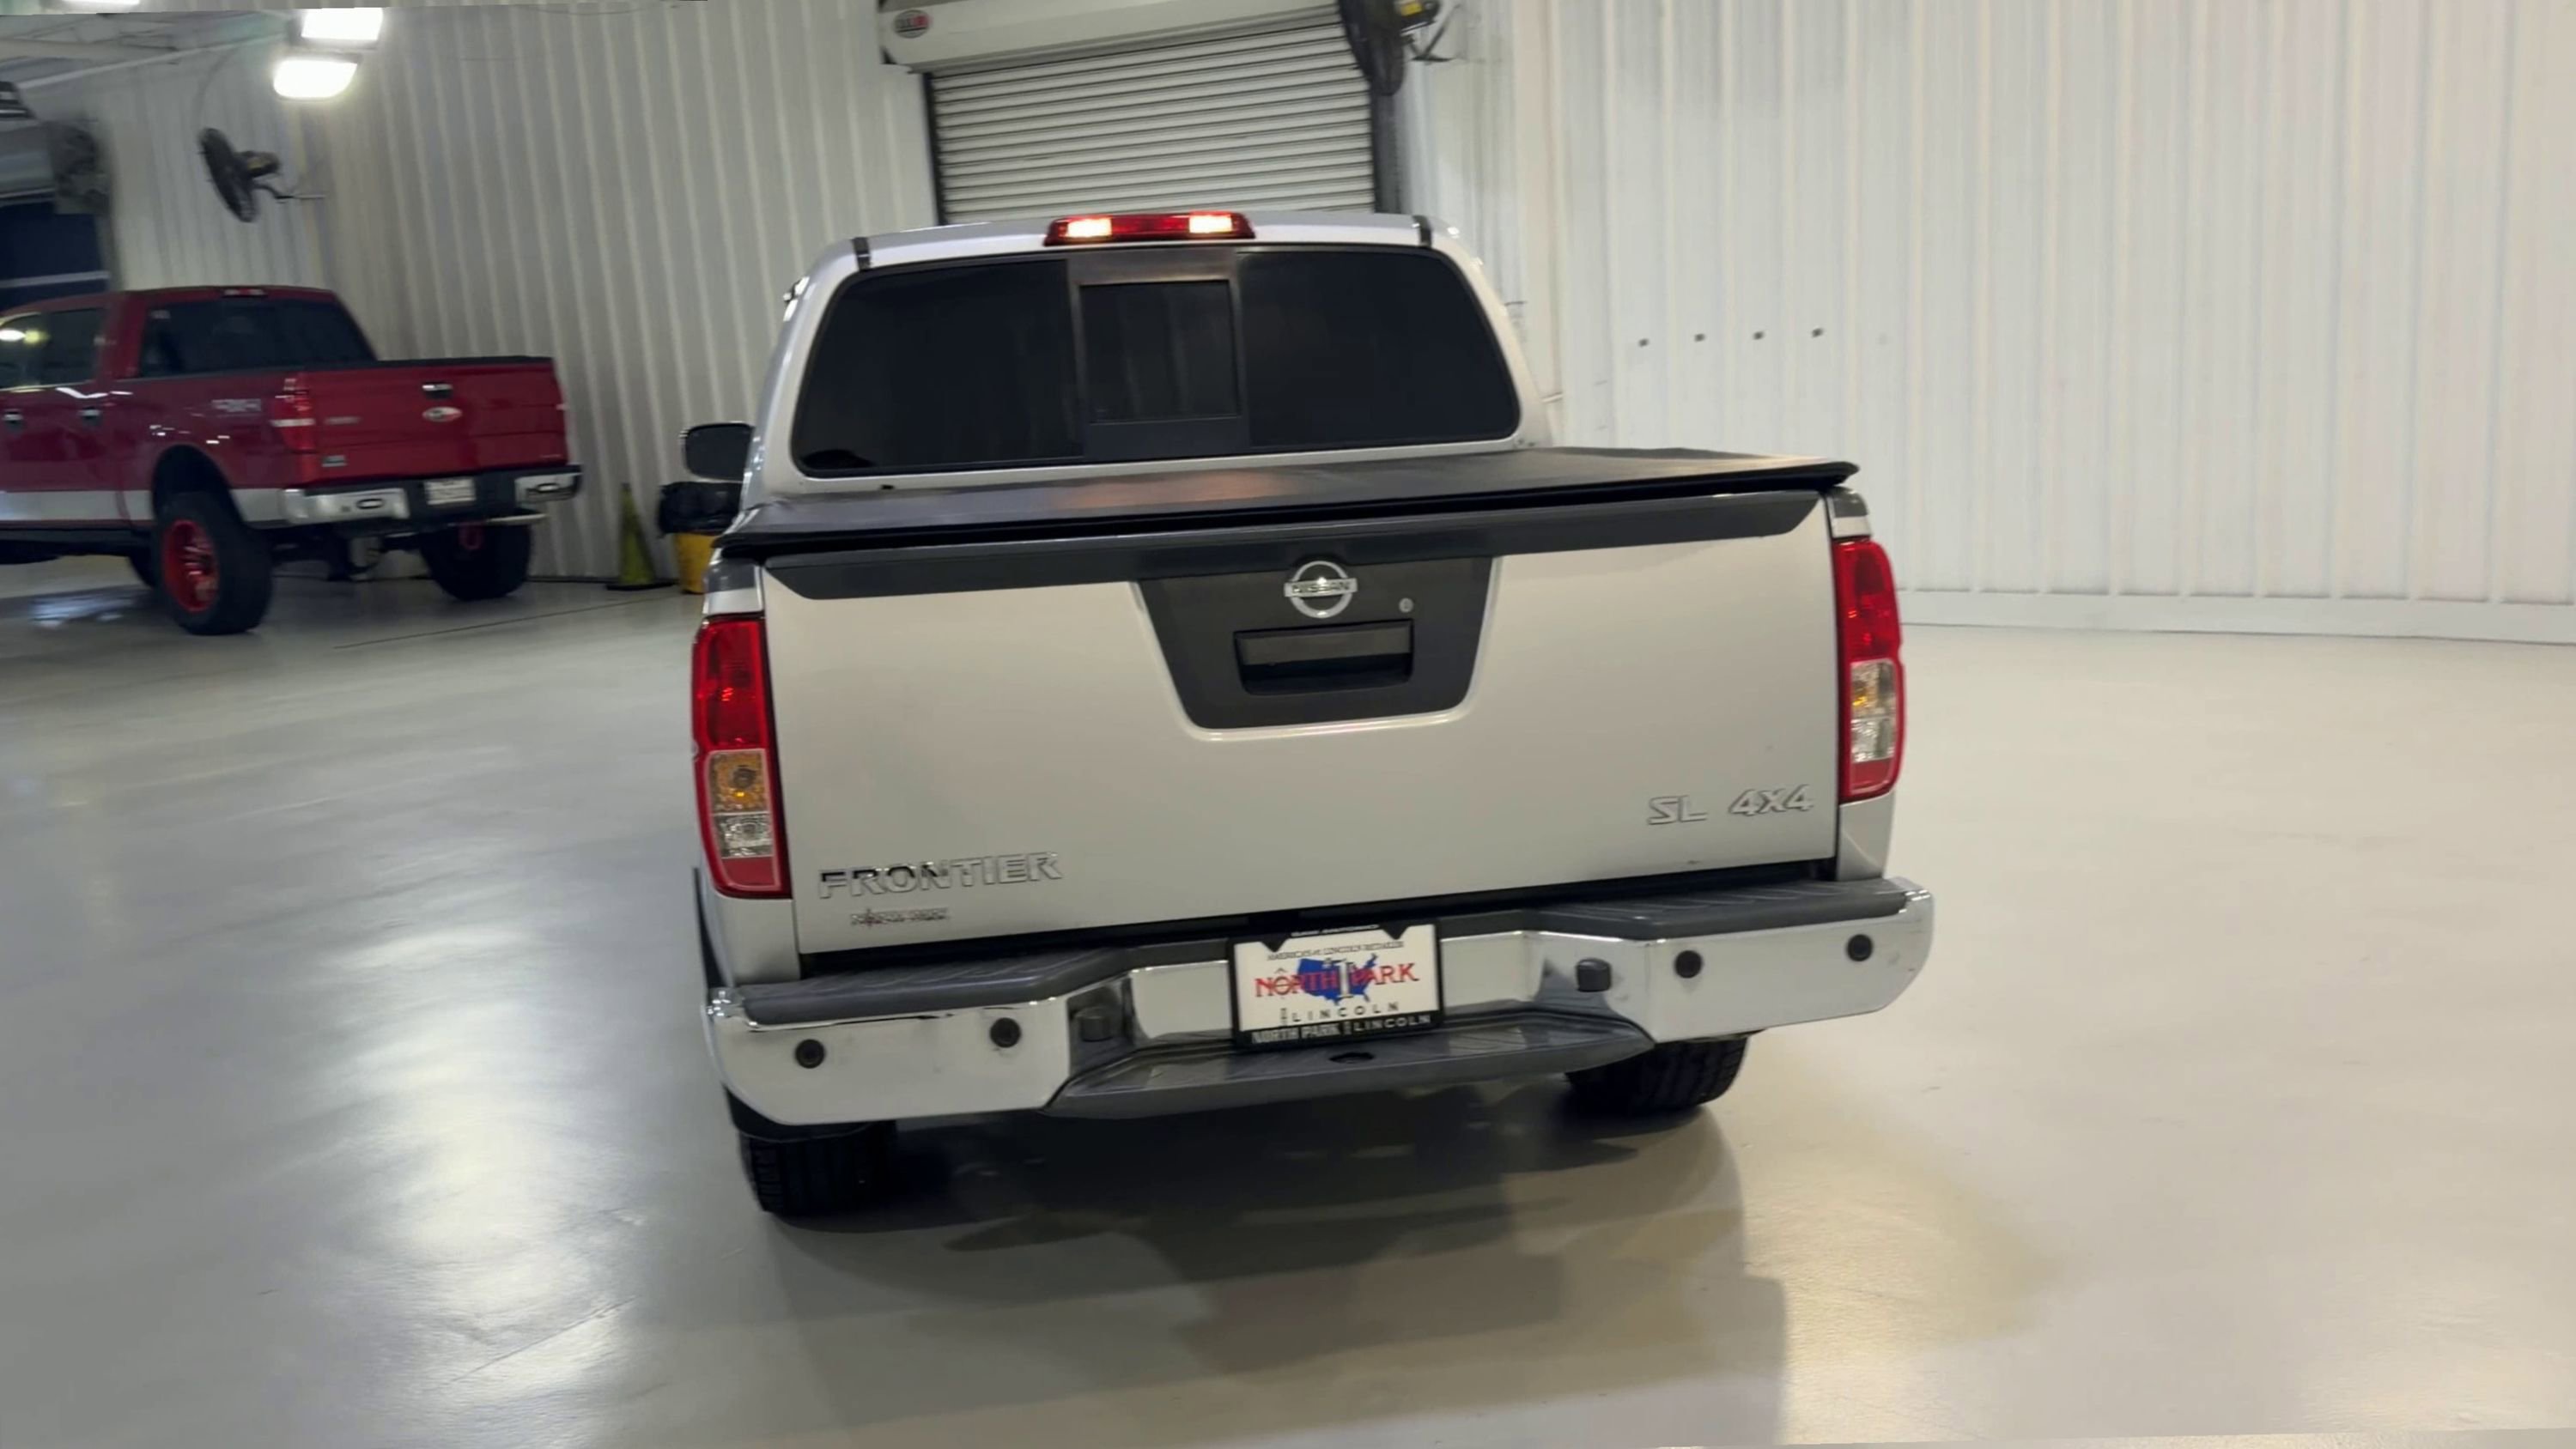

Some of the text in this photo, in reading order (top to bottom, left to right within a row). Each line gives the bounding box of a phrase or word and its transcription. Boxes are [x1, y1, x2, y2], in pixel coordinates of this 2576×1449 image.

[1646, 795, 1708, 825] SL
[818, 852, 1063, 899] FRONTIER
[1255, 962, 1420, 997] NORTH PARK
[1291, 1002, 1400, 1022] LINCOLN
[1251, 1027, 1299, 1044] NORTH
[1301, 1022, 1340, 1040] PARK
[1353, 1014, 1431, 1032] LINCOLN
